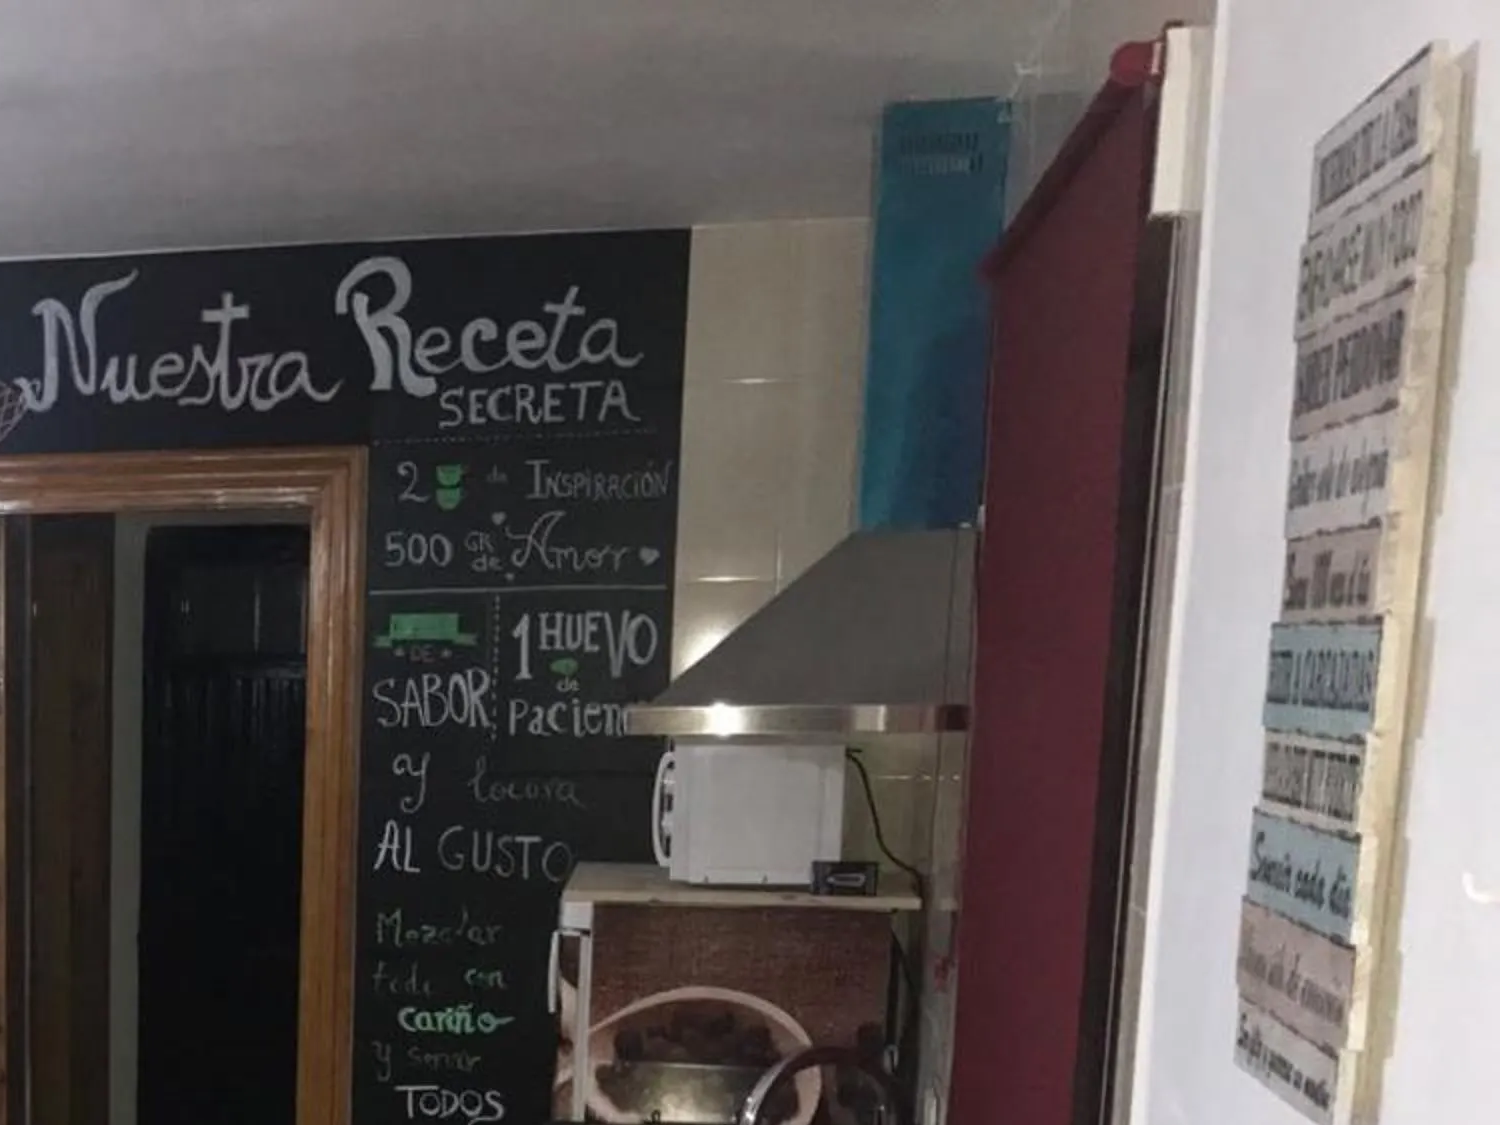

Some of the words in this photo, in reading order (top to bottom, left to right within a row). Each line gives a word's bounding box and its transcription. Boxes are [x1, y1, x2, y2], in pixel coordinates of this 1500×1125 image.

[17, 269, 346, 412] Nuestra
[336, 256, 644, 397] Receta
[439, 380, 641, 429] SECRETA
[396, 460, 430, 502] 2
[384, 531, 453, 568] 500
[471, 552, 503, 572] de
[505, 510, 630, 572] Amor
[511, 612, 533, 681] 1
[537, 609, 658, 679] HUEVO
[371, 667, 492, 729] SABOR
[555, 675, 581, 693] de
[374, 820, 421, 873] AL
[436, 825, 575, 883] GUSTO
